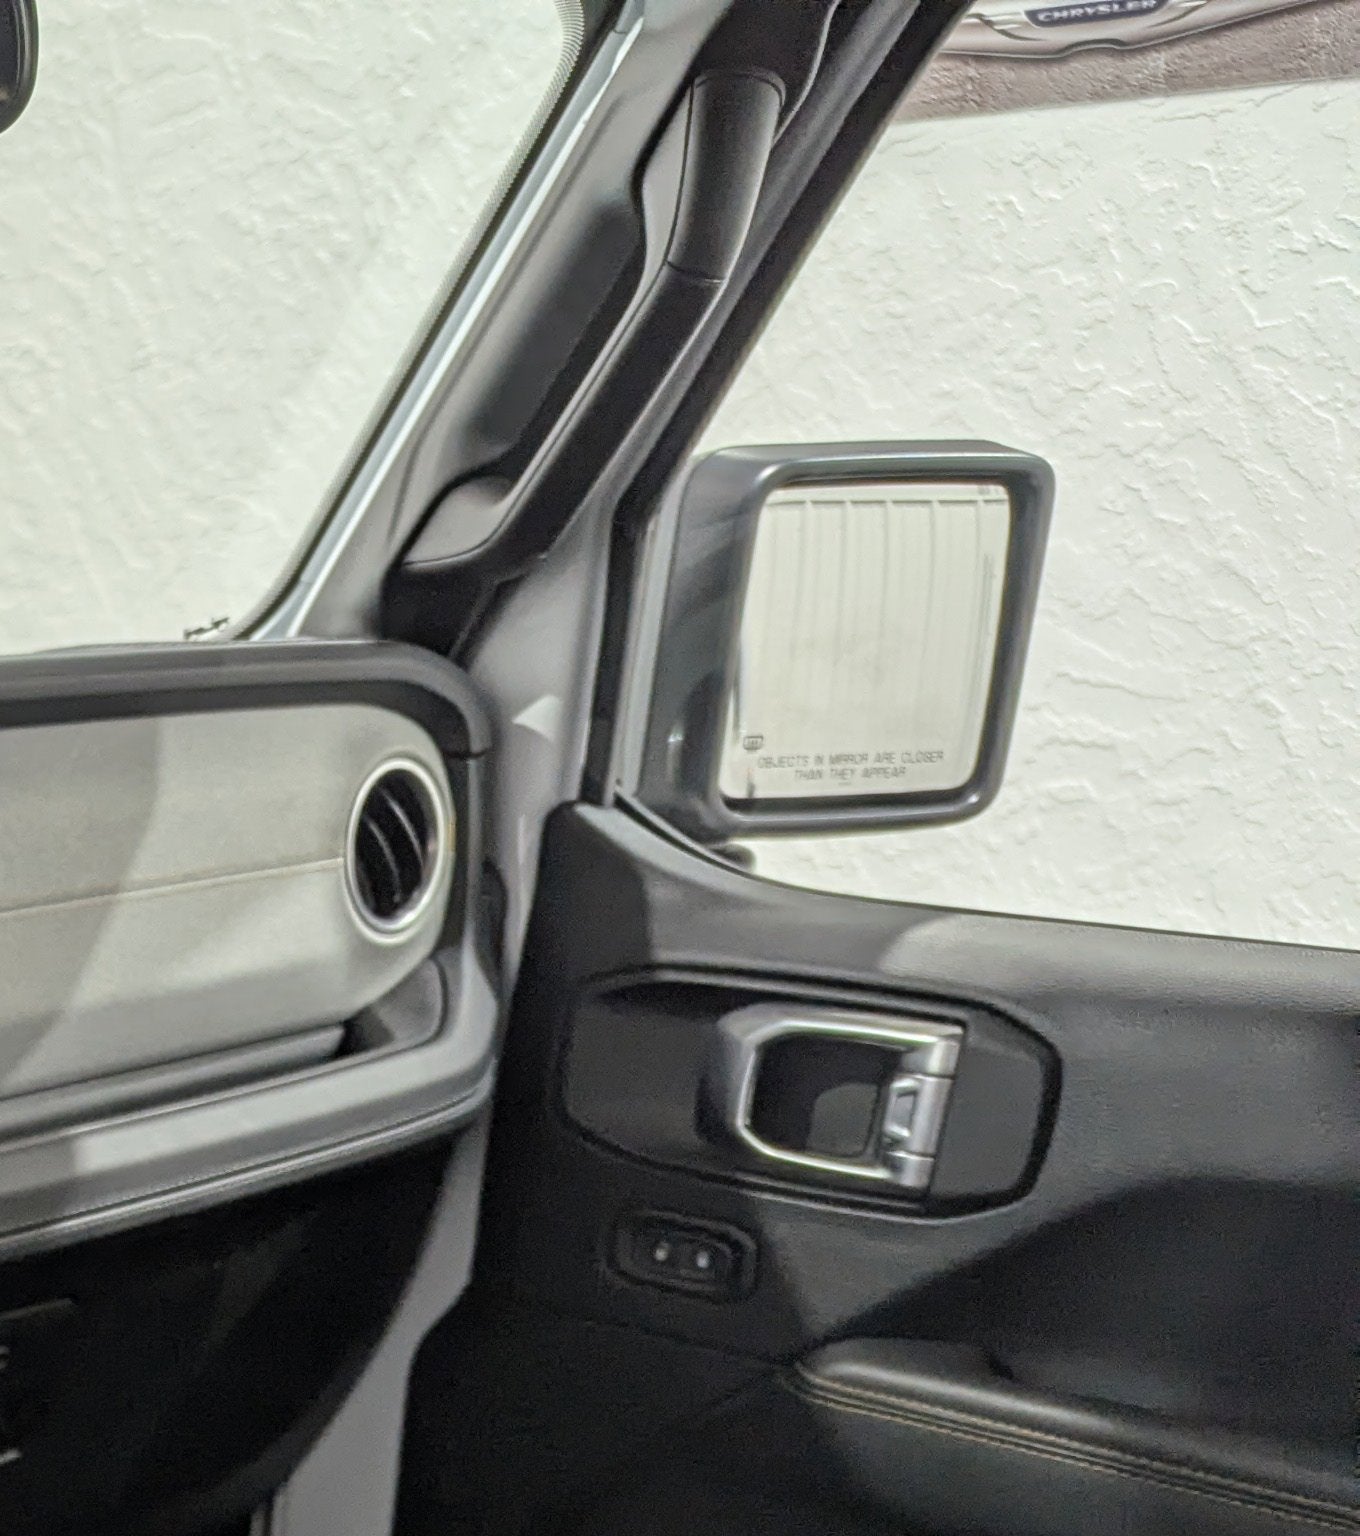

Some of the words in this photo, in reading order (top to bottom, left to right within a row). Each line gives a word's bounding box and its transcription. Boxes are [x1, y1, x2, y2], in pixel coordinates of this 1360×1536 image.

[1037, 0, 1157, 22] CHRYSLER
[757, 754, 809, 769] OBJECTS
[815, 754, 824, 765] IN
[829, 752, 869, 766] MIRROR
[874, 751, 896, 764] ARE
[901, 750, 944, 764] CLOSER
[795, 769, 823, 780] THAN
[830, 768, 856, 780] THEY
[861, 766, 907, 779] APPEAR
